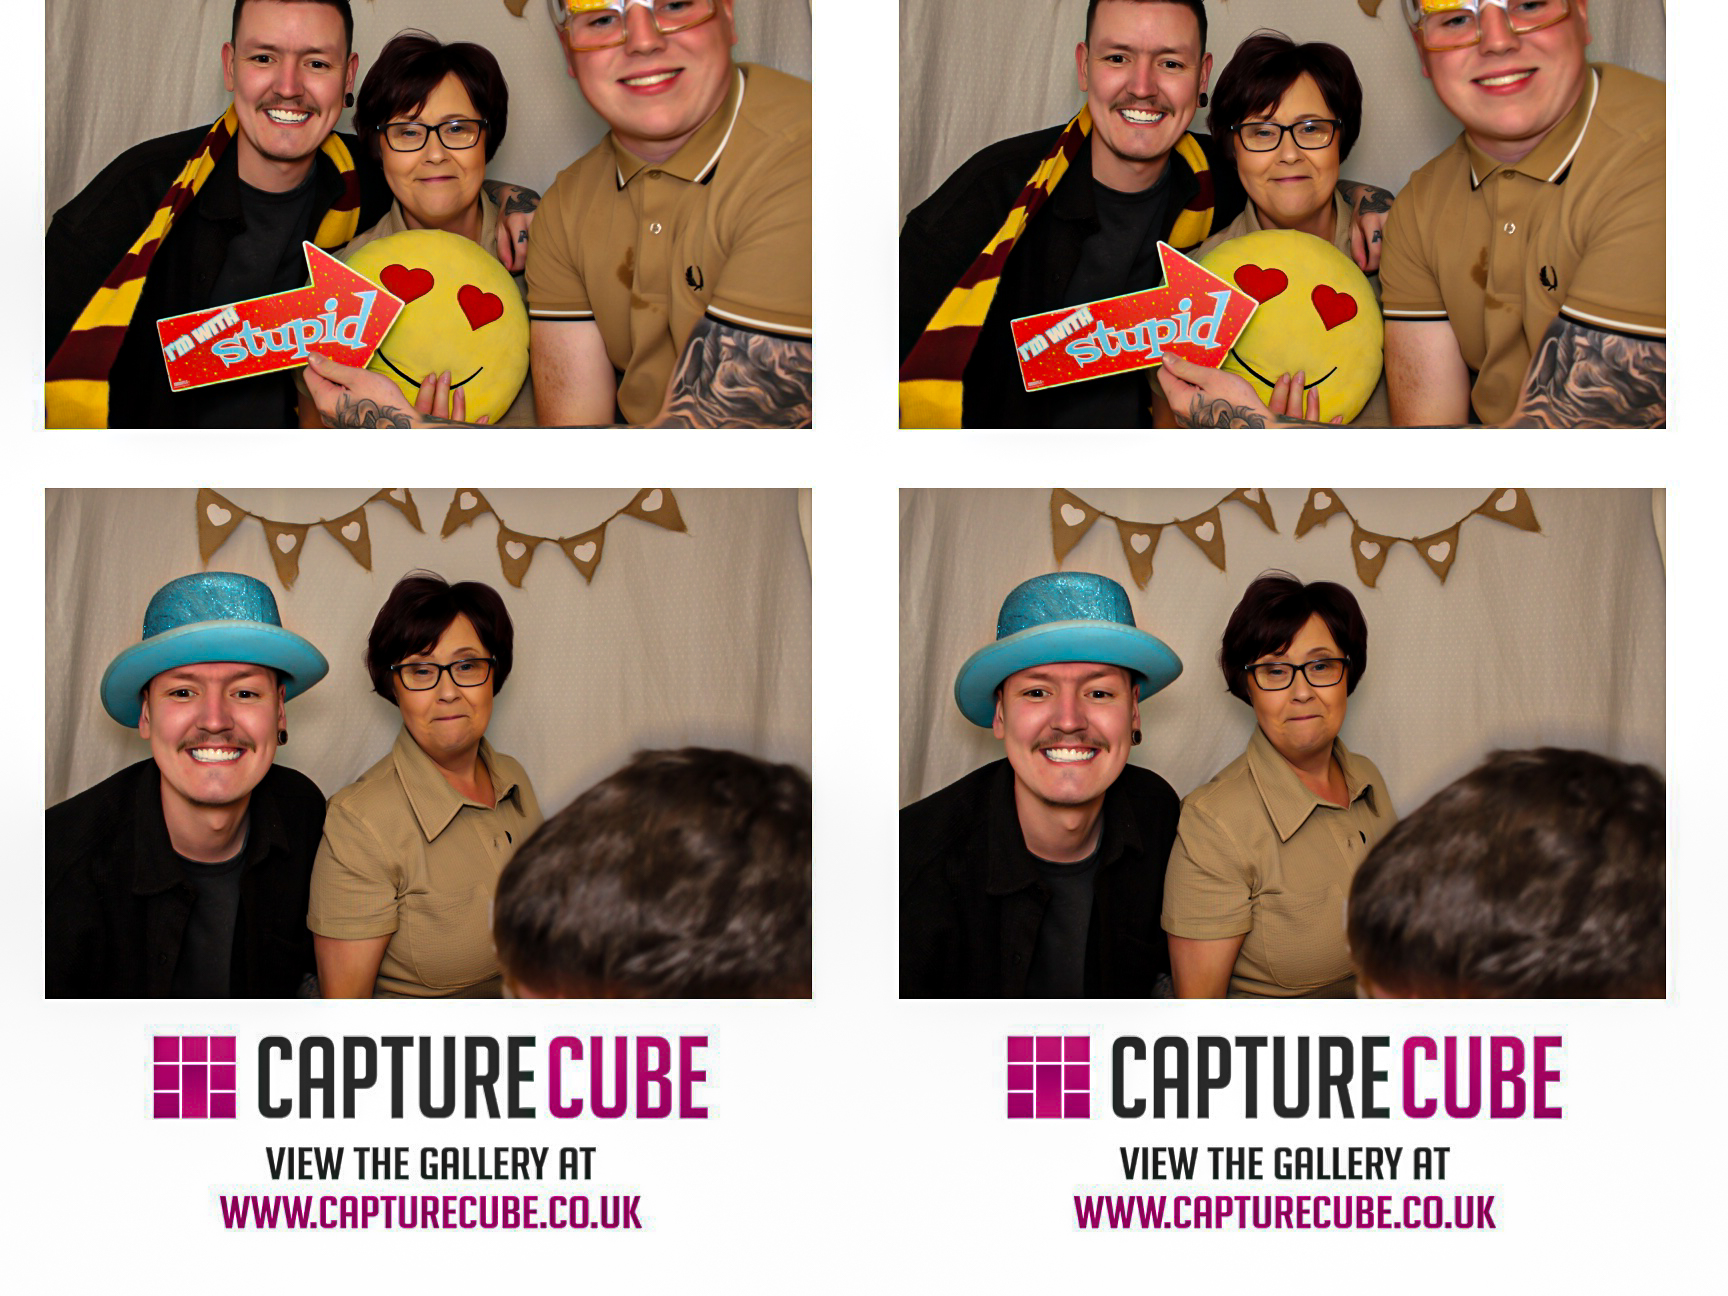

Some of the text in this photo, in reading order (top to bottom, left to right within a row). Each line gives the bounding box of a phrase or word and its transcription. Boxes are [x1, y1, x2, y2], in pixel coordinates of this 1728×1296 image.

[191, 306, 240, 345] WITH
[211, 290, 377, 368] stupid
[1045, 306, 1094, 345] WITH
[1065, 290, 1231, 368] stupid
